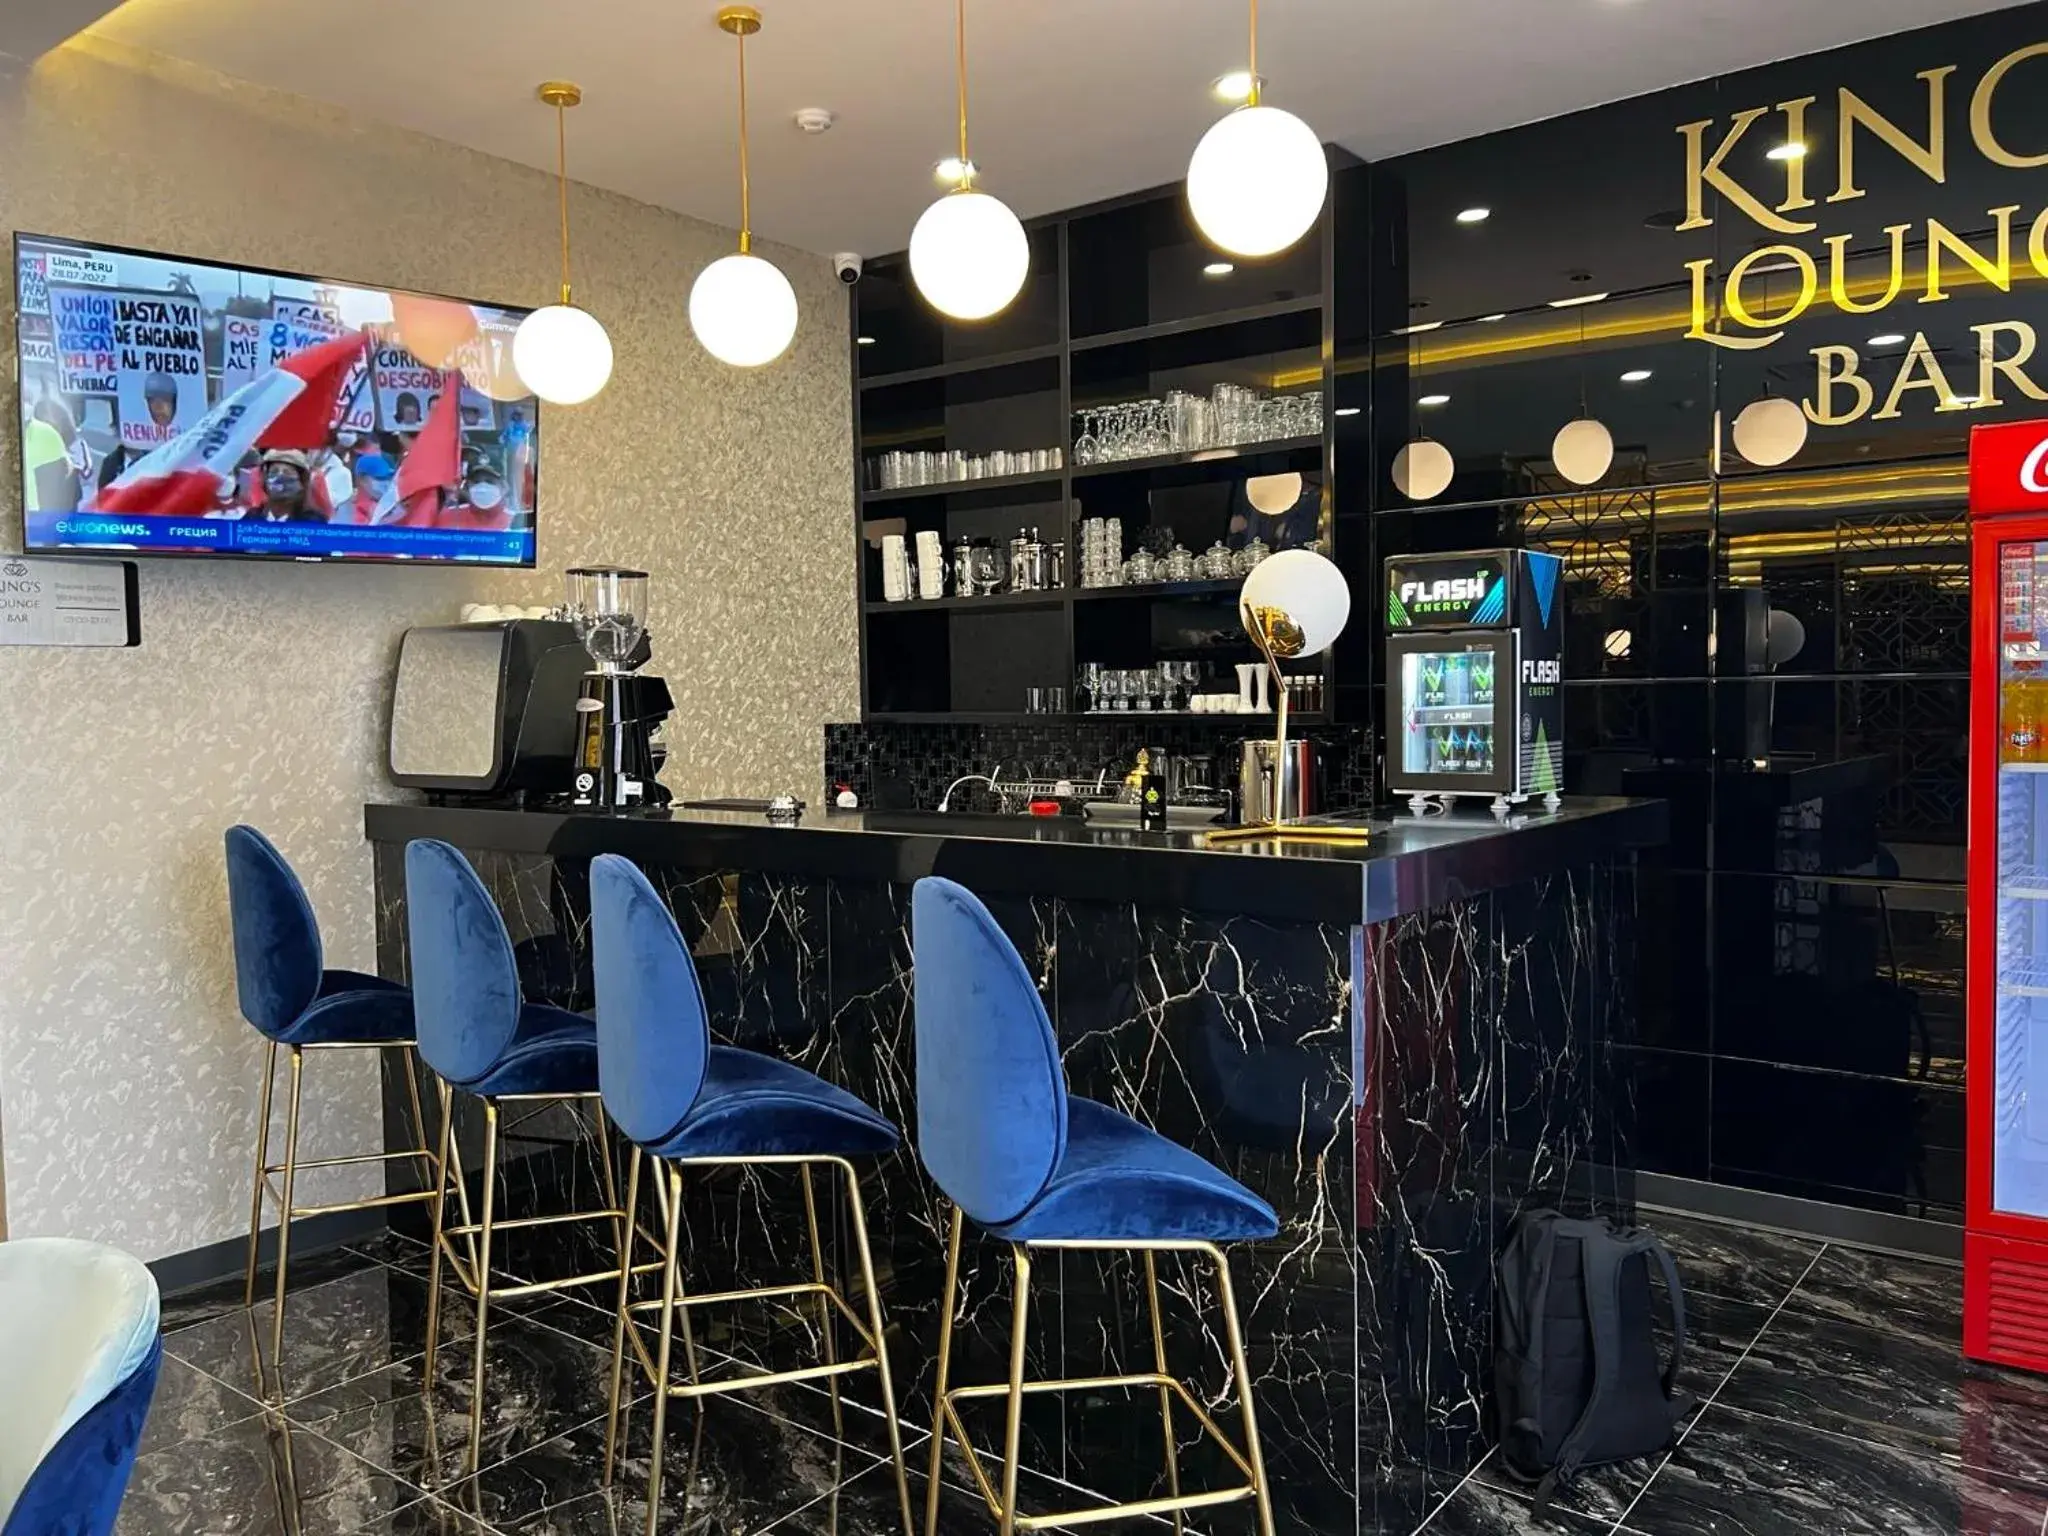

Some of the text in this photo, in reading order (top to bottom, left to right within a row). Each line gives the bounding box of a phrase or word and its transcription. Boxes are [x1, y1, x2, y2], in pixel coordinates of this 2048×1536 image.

[52, 257, 82, 270] Lima,
[84, 261, 113, 273] PERU
[1684, 205, 2048, 350] LOUN
[55, 315, 112, 334] VALOR
[170, 304, 198, 327] YA!
[114, 324, 132, 345] DE
[269, 322, 288, 347] 8
[122, 350, 199, 375] AL PUEBLO
[1802, 320, 2048, 426] BAR
[169, 526, 218, 538] ГРЕЦИЯ
[0, 580, 42, 593] ING'S
[1402, 577, 1485, 603] FLASH
[1414, 601, 1472, 613] ENERGY
[7, 614, 29, 623] BAR
[1522, 660, 1561, 684] FLASH
